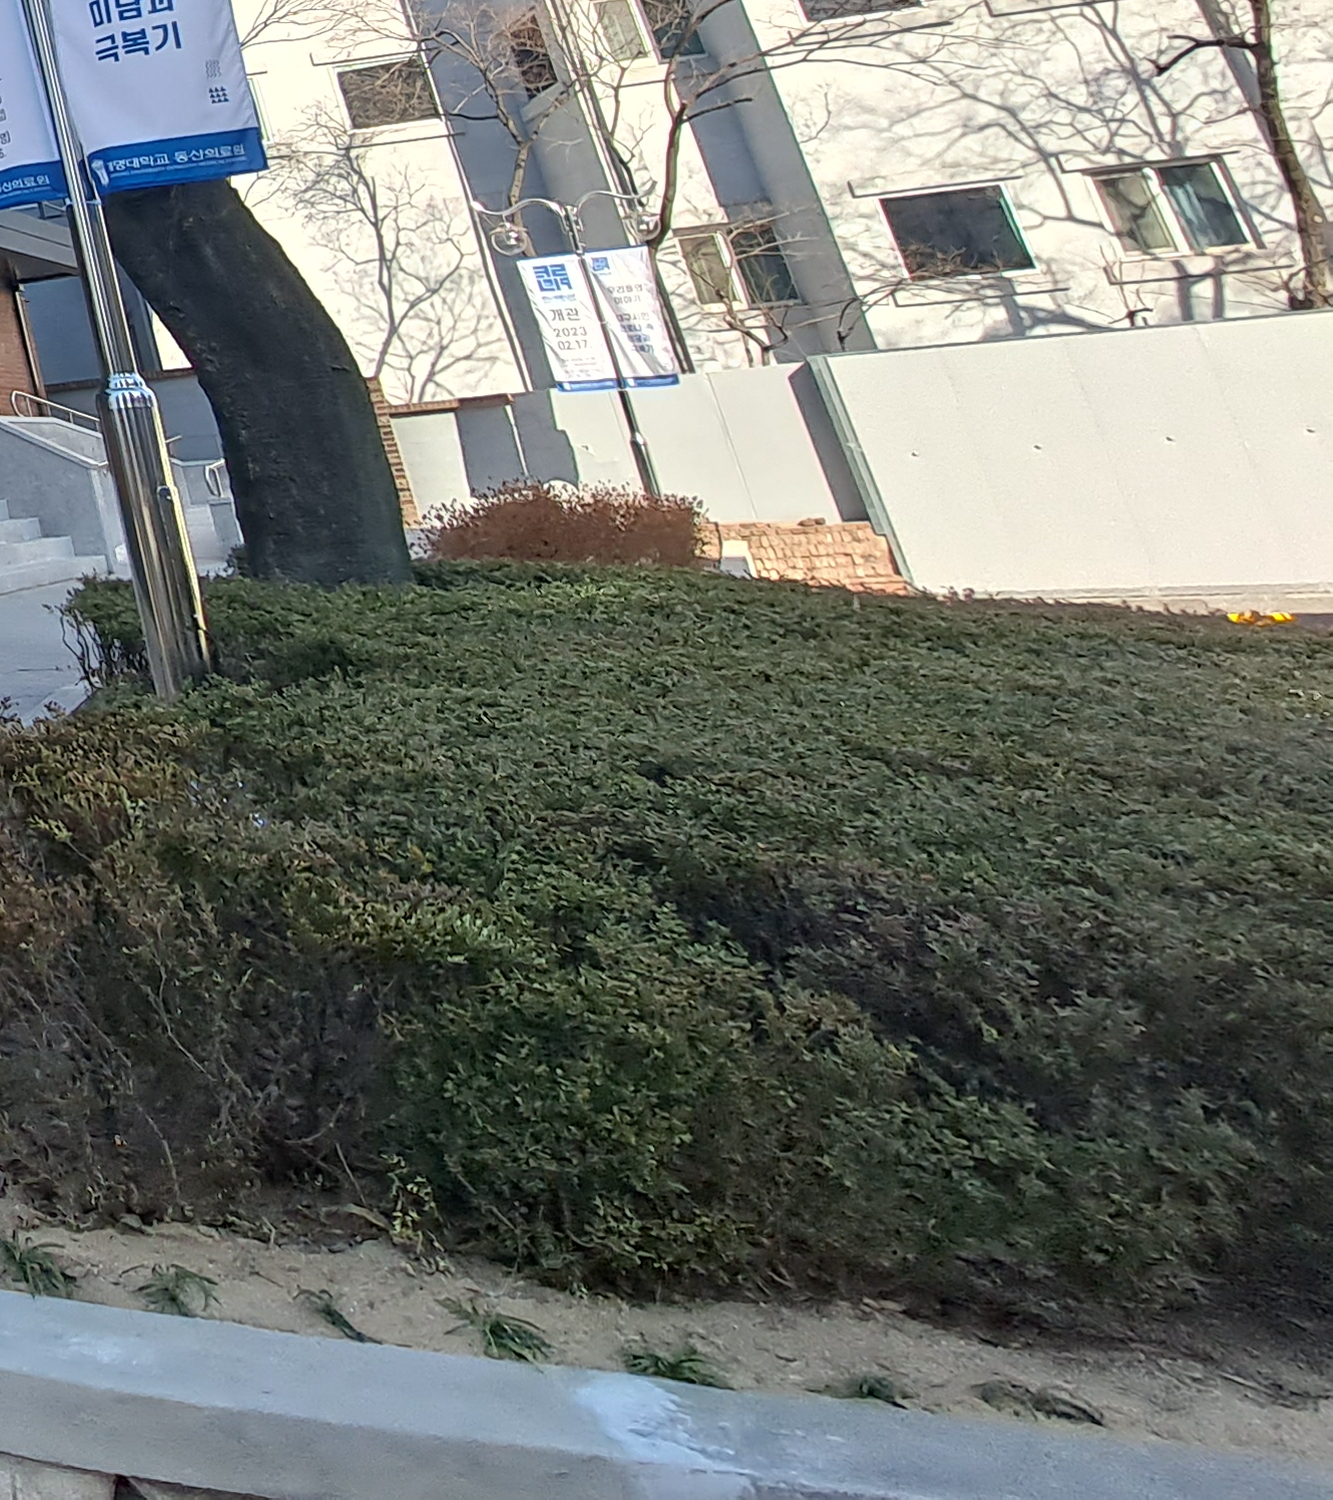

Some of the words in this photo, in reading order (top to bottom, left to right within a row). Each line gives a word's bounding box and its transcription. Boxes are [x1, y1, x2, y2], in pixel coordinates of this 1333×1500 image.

[95, 21, 182, 62] 극복기
[549, 308, 581, 321] 개관
[553, 326, 588, 338] 2023
